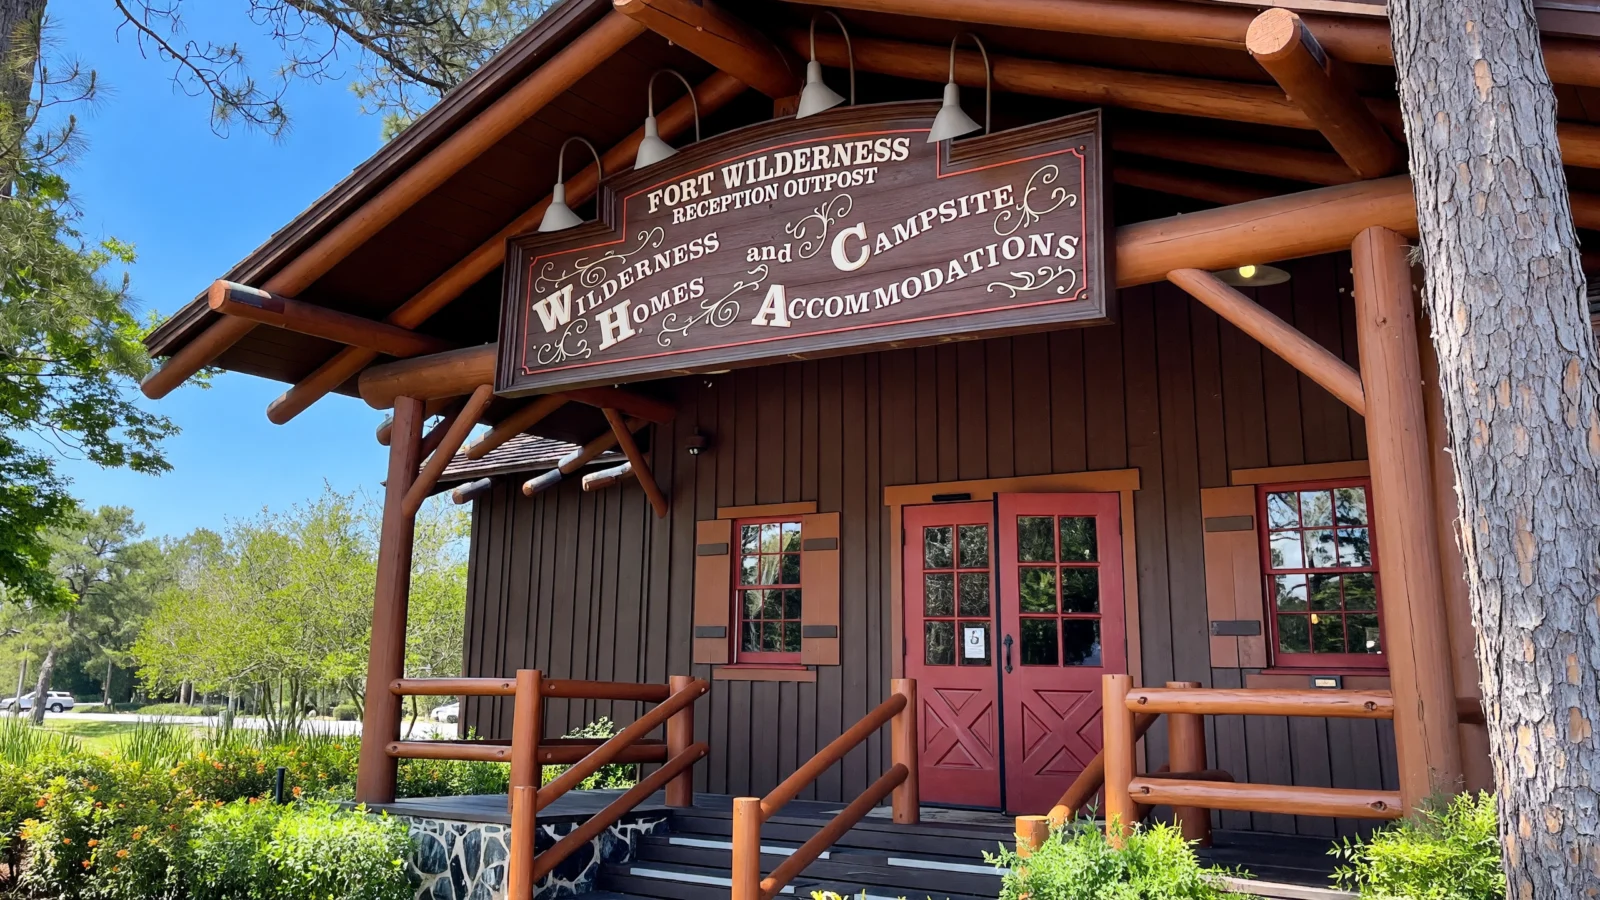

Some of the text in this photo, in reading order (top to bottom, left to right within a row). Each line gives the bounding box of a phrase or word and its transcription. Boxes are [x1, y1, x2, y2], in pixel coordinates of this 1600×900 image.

[647, 137, 911, 213] FORT WILDERNESS
[672, 166, 878, 225] RECEPTION OUTPOST
[746, 243, 793, 264] and
[830, 184, 1016, 272] CAMPSITE
[532, 231, 720, 333] WILDERNESS
[595, 277, 705, 351] HOMES
[751, 232, 1080, 328] ACCOMMODATIONS
